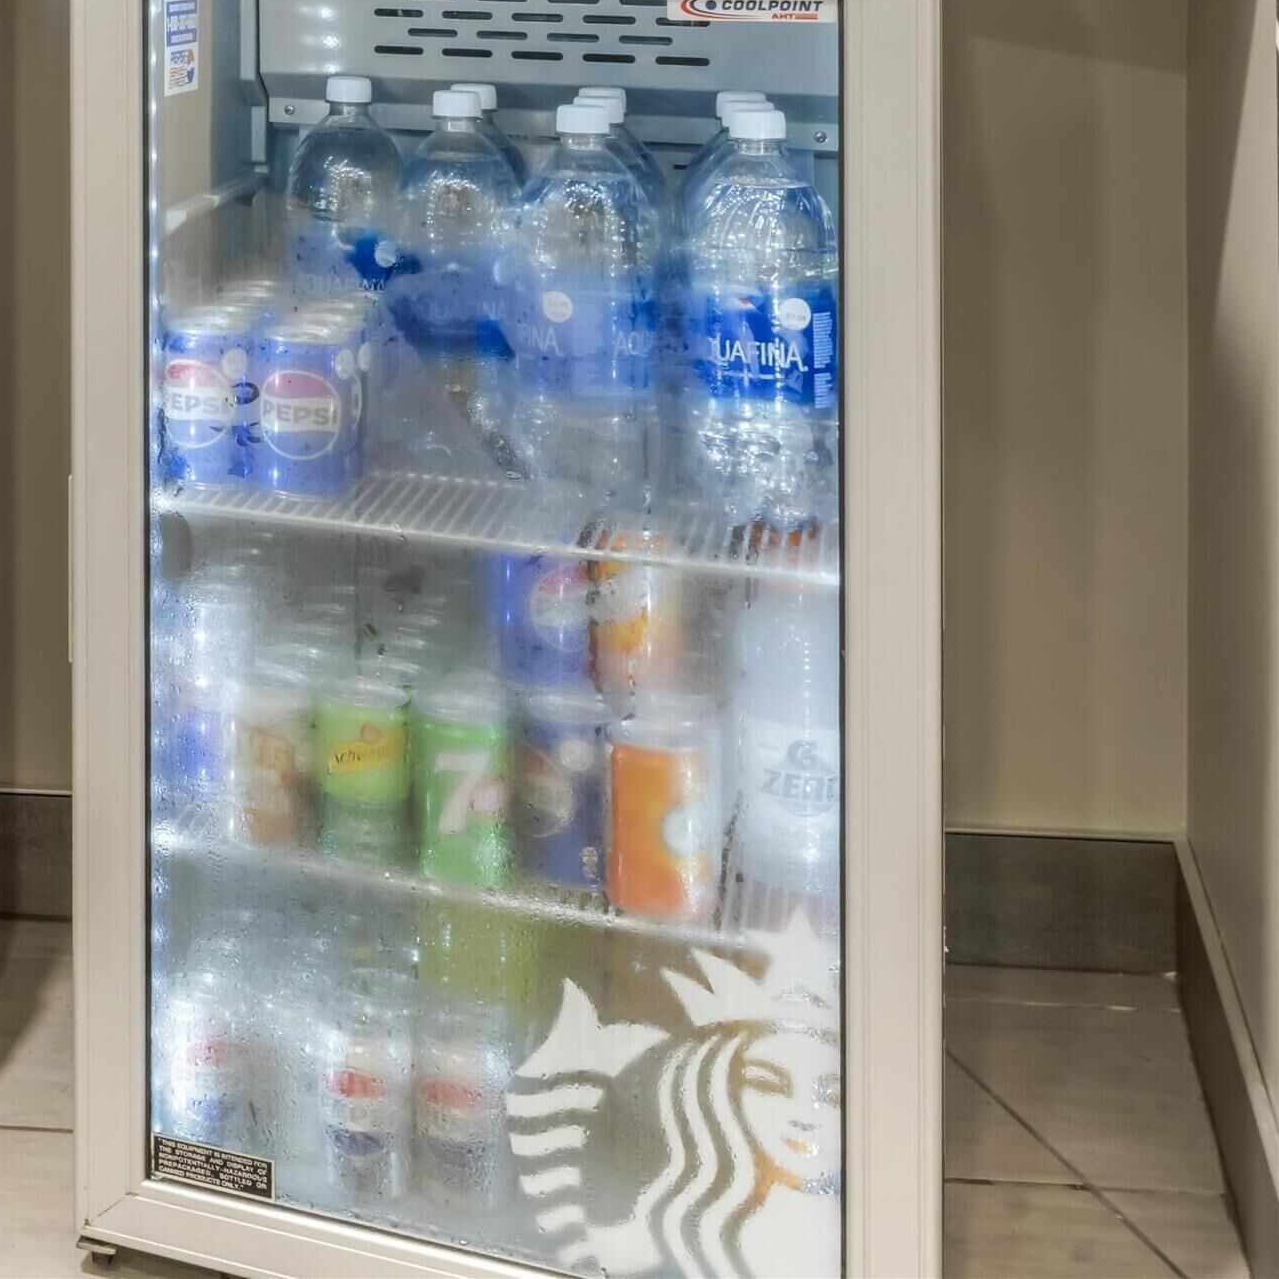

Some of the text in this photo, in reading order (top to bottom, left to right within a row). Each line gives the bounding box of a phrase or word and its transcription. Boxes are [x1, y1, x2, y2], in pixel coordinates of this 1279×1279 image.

[722, 0, 823, 11] COOLPOINT
[262, 400, 338, 425] PEPSI
[159, 1145, 172, 1153] THE
[175, 1149, 206, 1161] STORAGE
[209, 1158, 224, 1166] AND
[226, 1161, 254, 1173] DISPLAY
[177, 1143, 212, 1156] EQUIPMENT
[253, 1160, 267, 1168] FOR
[185, 1172, 220, 1185] PRODUCTS
[219, 1172, 252, 1186] BOTTLED
[256, 1182, 267, 1190] OR
